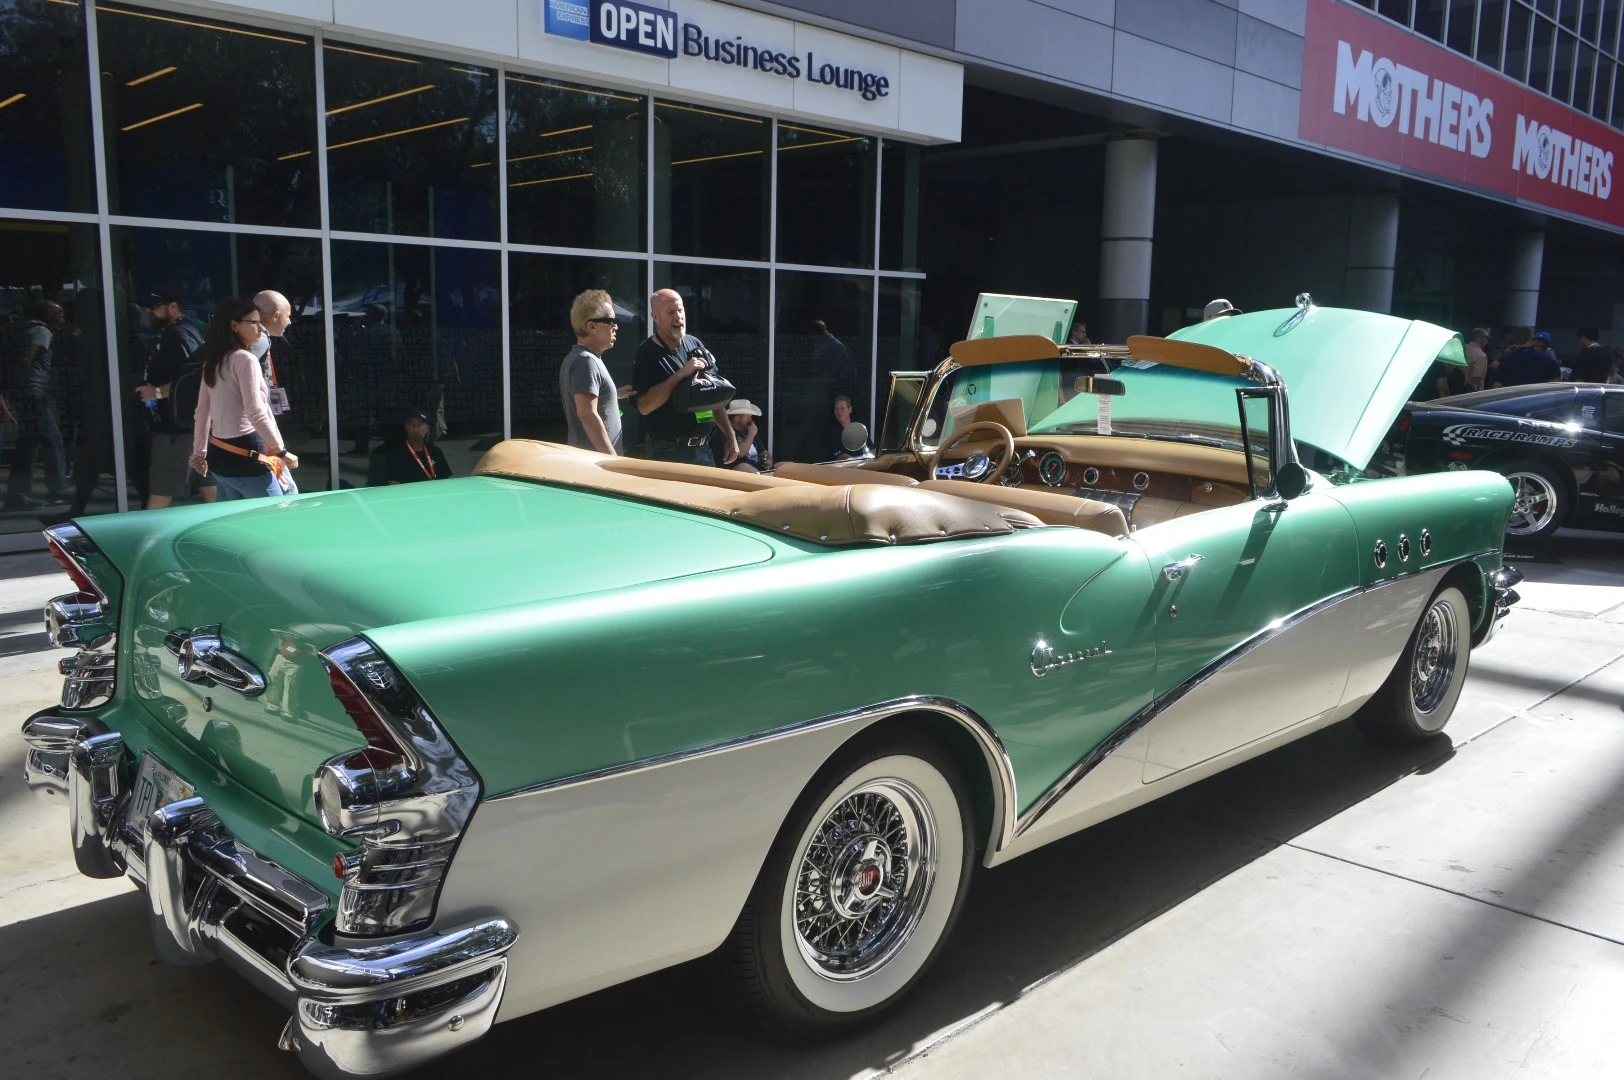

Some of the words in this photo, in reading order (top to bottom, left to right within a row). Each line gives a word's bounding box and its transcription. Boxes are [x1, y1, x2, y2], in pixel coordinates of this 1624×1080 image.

[550, 0, 587, 15] AMERICAN
[557, 12, 590, 26] EXPRESS
[600, 3, 674, 51] OPEN
[683, 23, 800, 79] Business
[807, 52, 889, 101] Lounge
[1333, 40, 1494, 159] MOTHERS
[1512, 114, 1614, 200] MOTHERS
[1462, 428, 1513, 441] RACE
[1511, 432, 1580, 448] RAMPS
